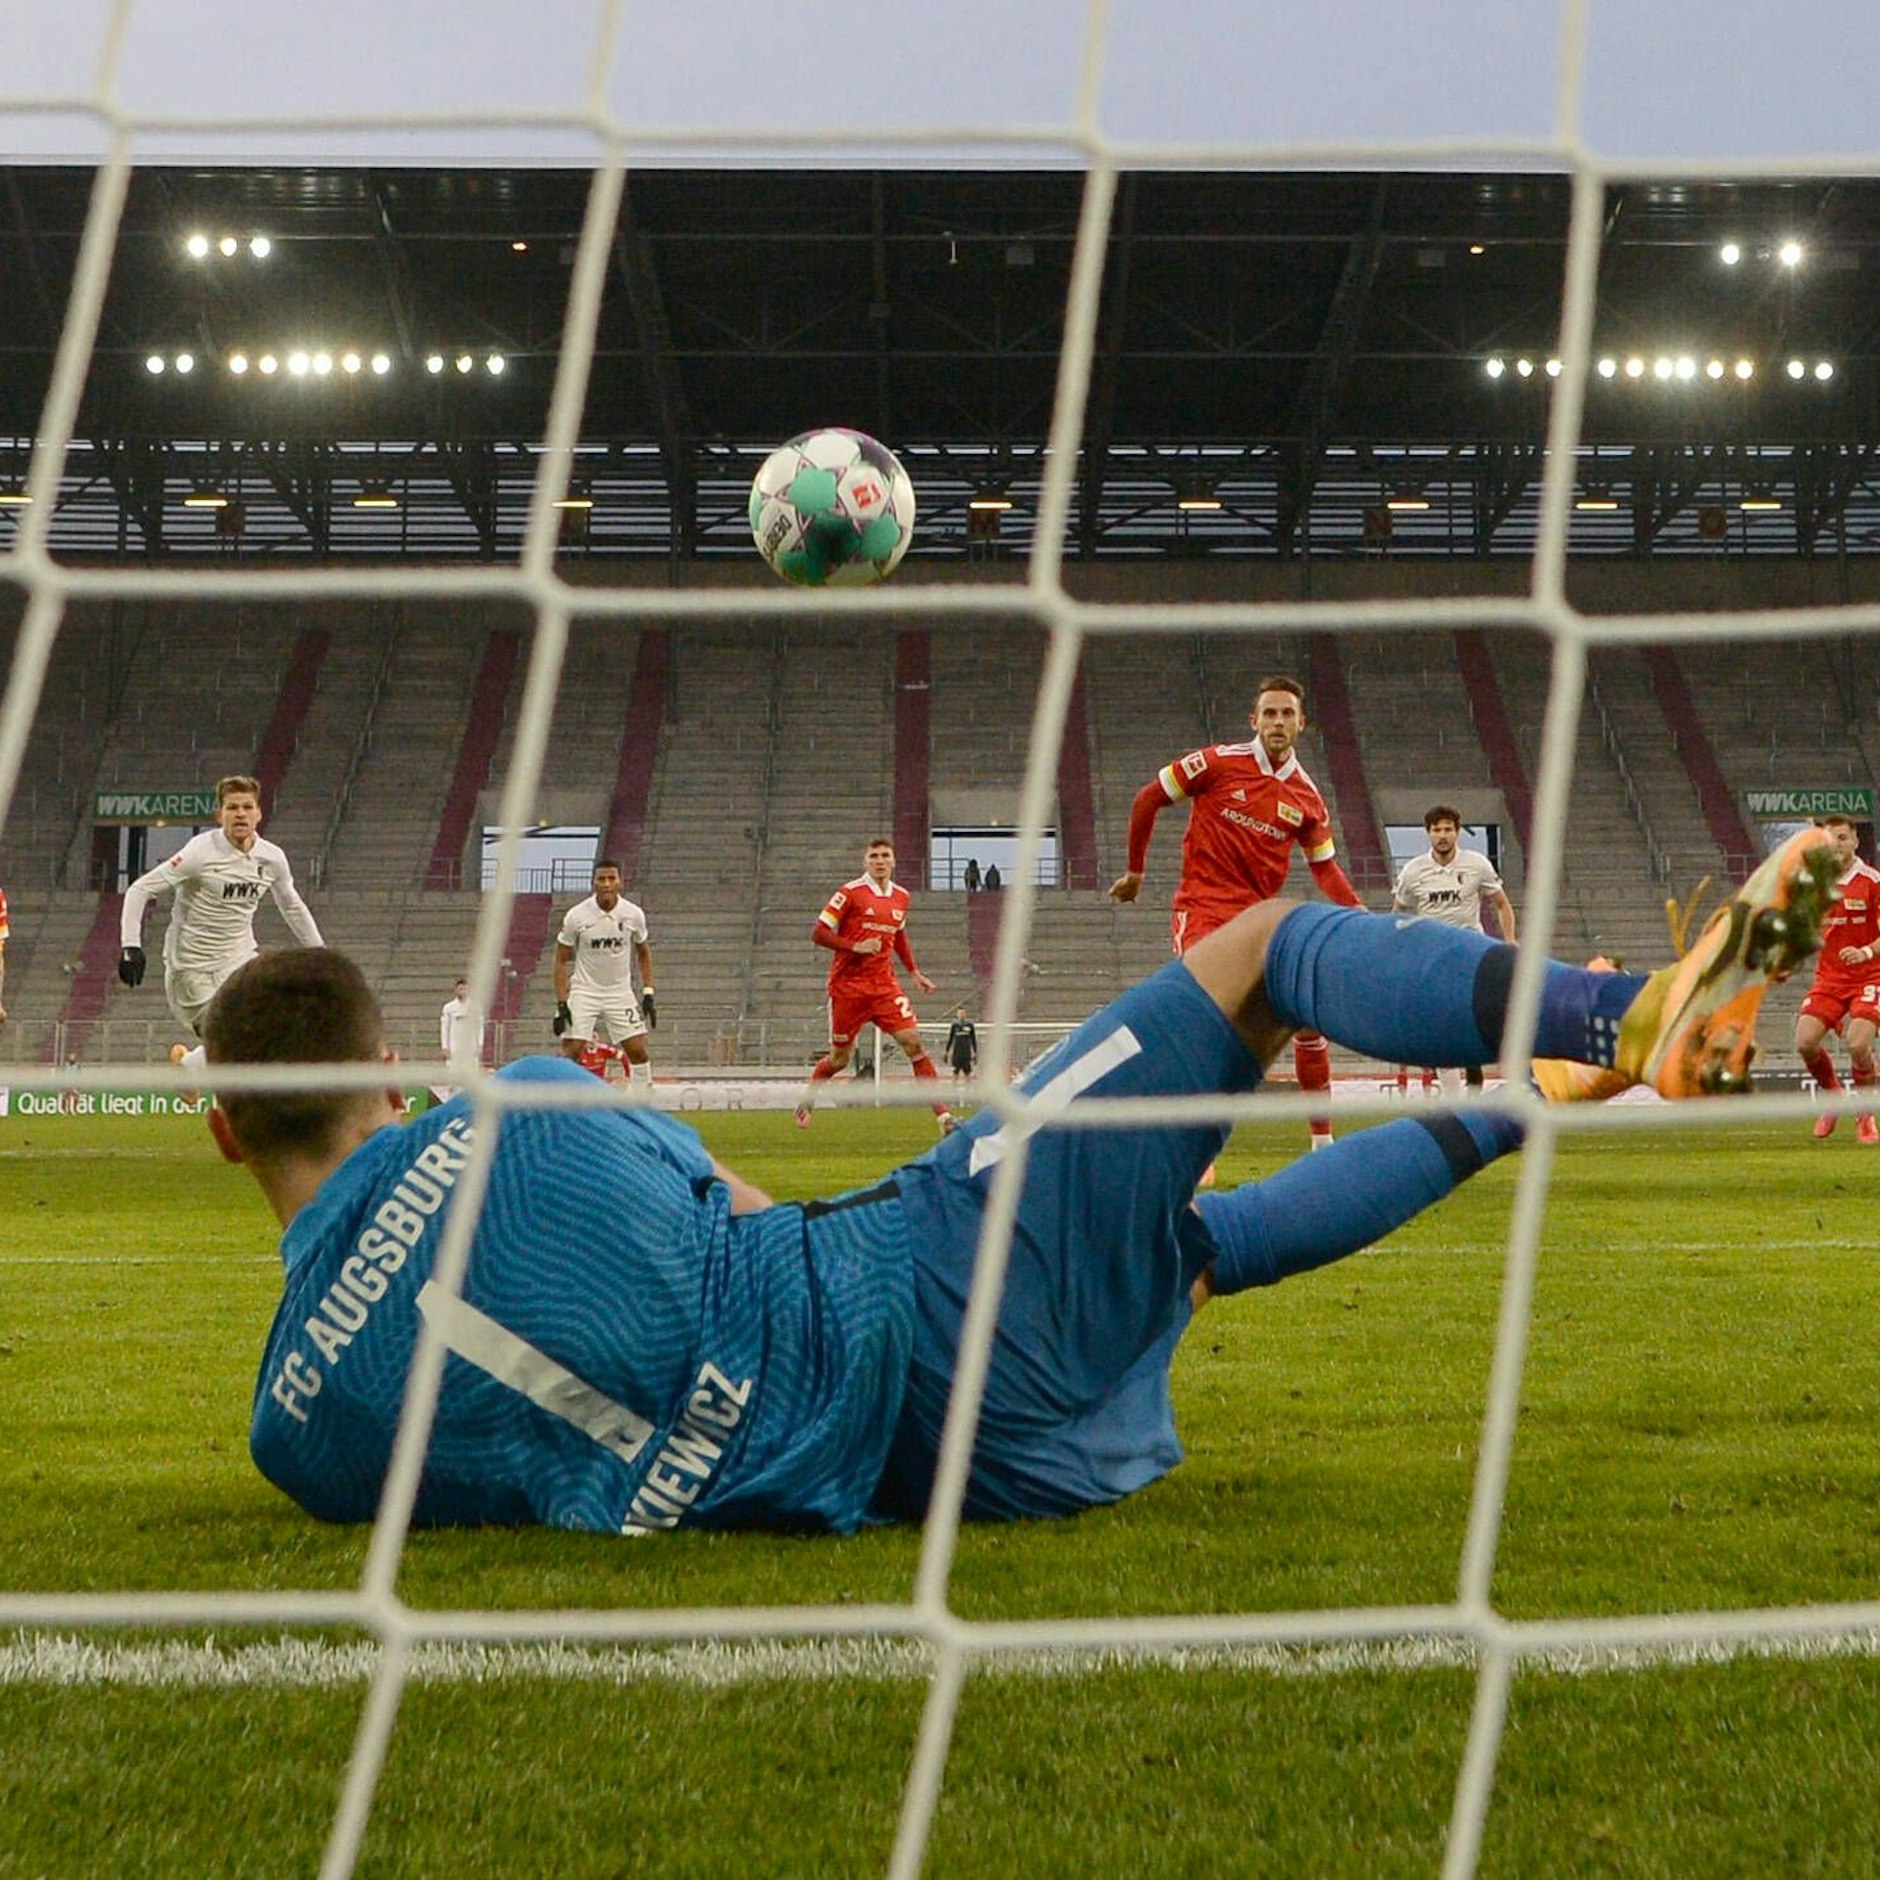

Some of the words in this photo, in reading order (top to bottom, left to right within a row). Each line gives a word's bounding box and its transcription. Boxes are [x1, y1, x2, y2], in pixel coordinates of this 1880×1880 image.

[222, 882, 260, 900] WWK
[1428, 889, 1462, 904] WWK
[150, 1093, 168, 1114] in
[271, 1350, 323, 1424] FC
[304, 1117, 475, 1367] AUGSBURG
